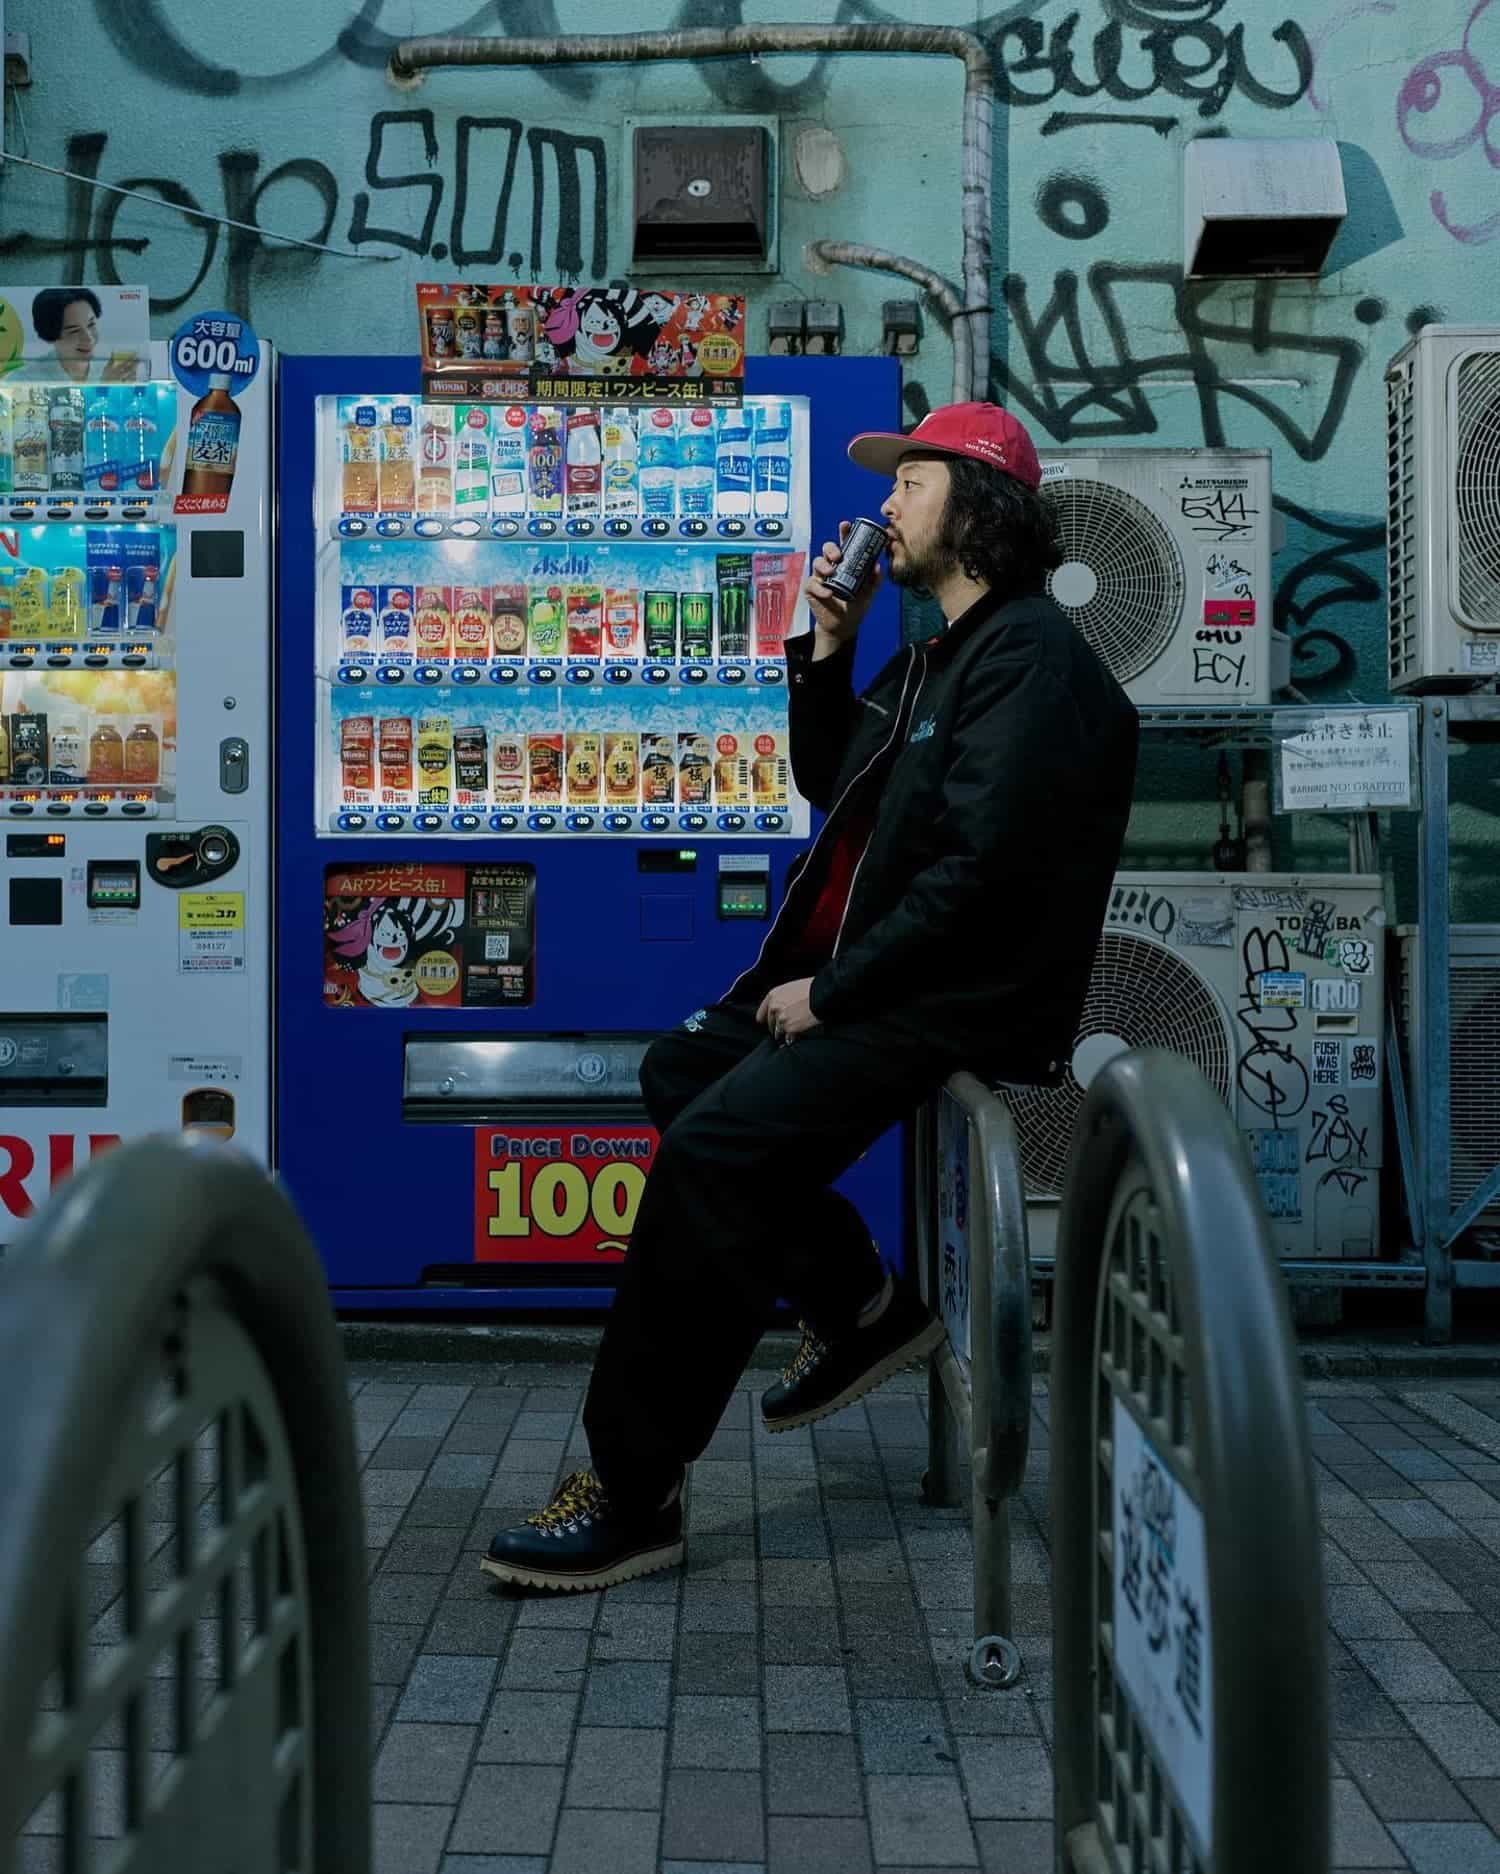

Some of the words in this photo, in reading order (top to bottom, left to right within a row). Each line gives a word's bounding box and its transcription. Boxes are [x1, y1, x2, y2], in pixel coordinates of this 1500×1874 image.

[195, 320, 241, 337] 大容量
[177, 337, 253, 374] 600ml
[536, 380, 609, 397] 期間限定!
[613, 382, 704, 399] ワンピース缶!
[196, 440, 231, 465] 麦茶
[1315, 1056, 1338, 1069] WAS
[1313, 1070, 1340, 1084] HERE
[488, 1161, 648, 1237] 100
